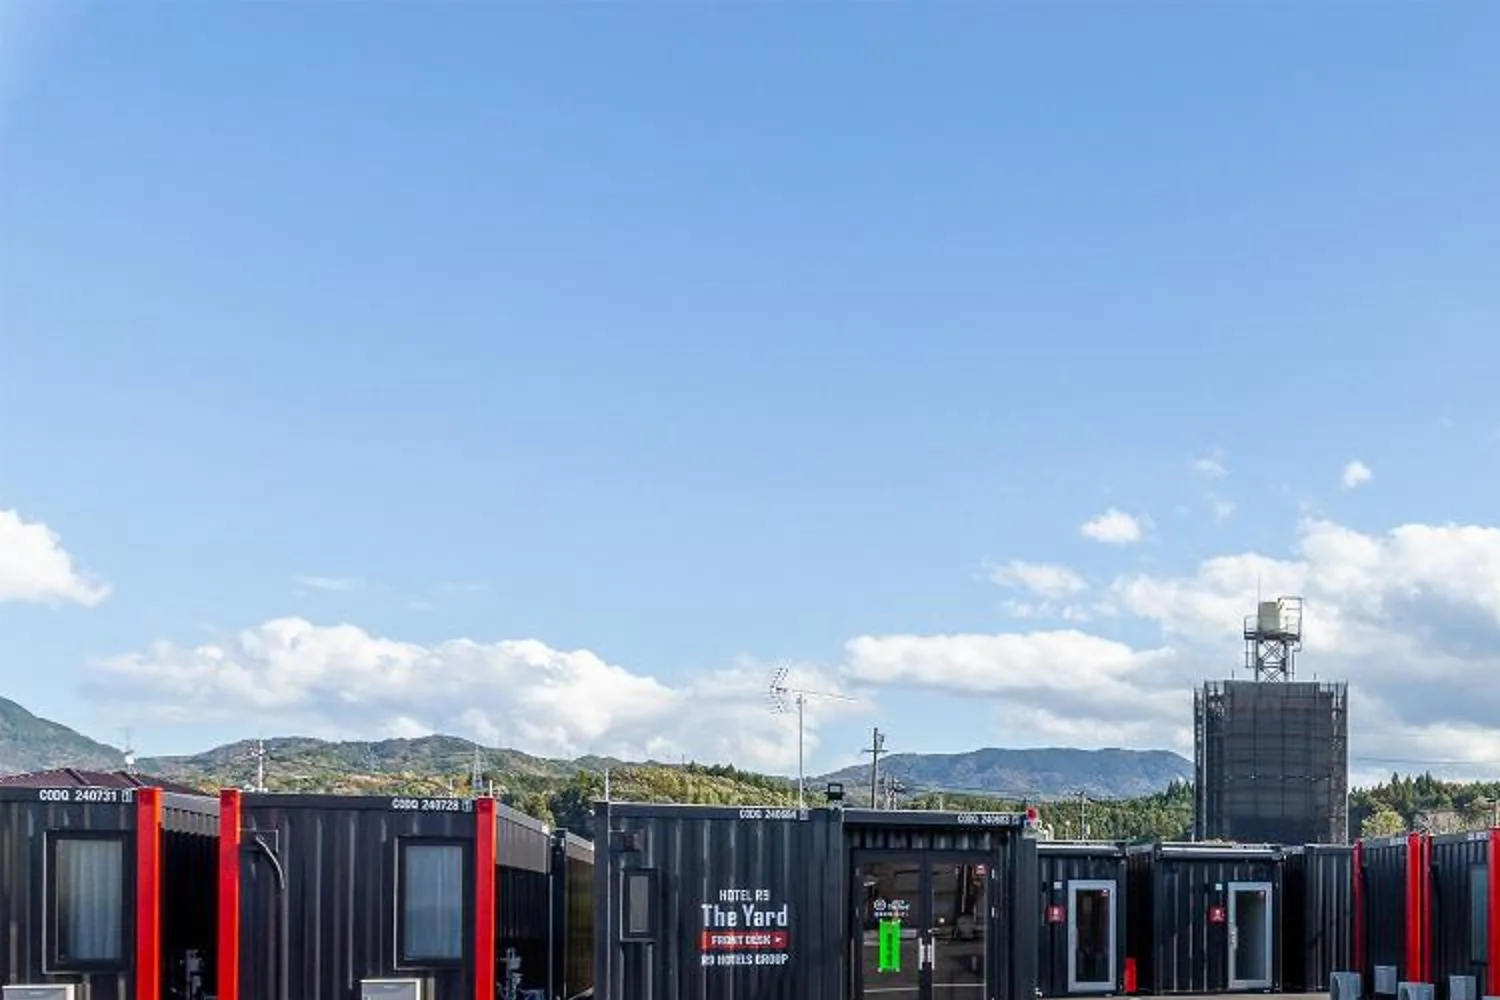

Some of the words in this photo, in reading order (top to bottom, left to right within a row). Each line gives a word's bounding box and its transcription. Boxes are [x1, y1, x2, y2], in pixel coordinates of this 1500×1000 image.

[75, 790, 117, 803] 240731
[719, 889, 753, 901] HOTEL
[701, 903, 737, 927] The
[742, 903, 788, 927] Yard
[711, 935, 743, 945] FRONT
[745, 935, 771, 945] DESK
[717, 954, 753, 965] HOTELS
[755, 953, 789, 965] GROUP
